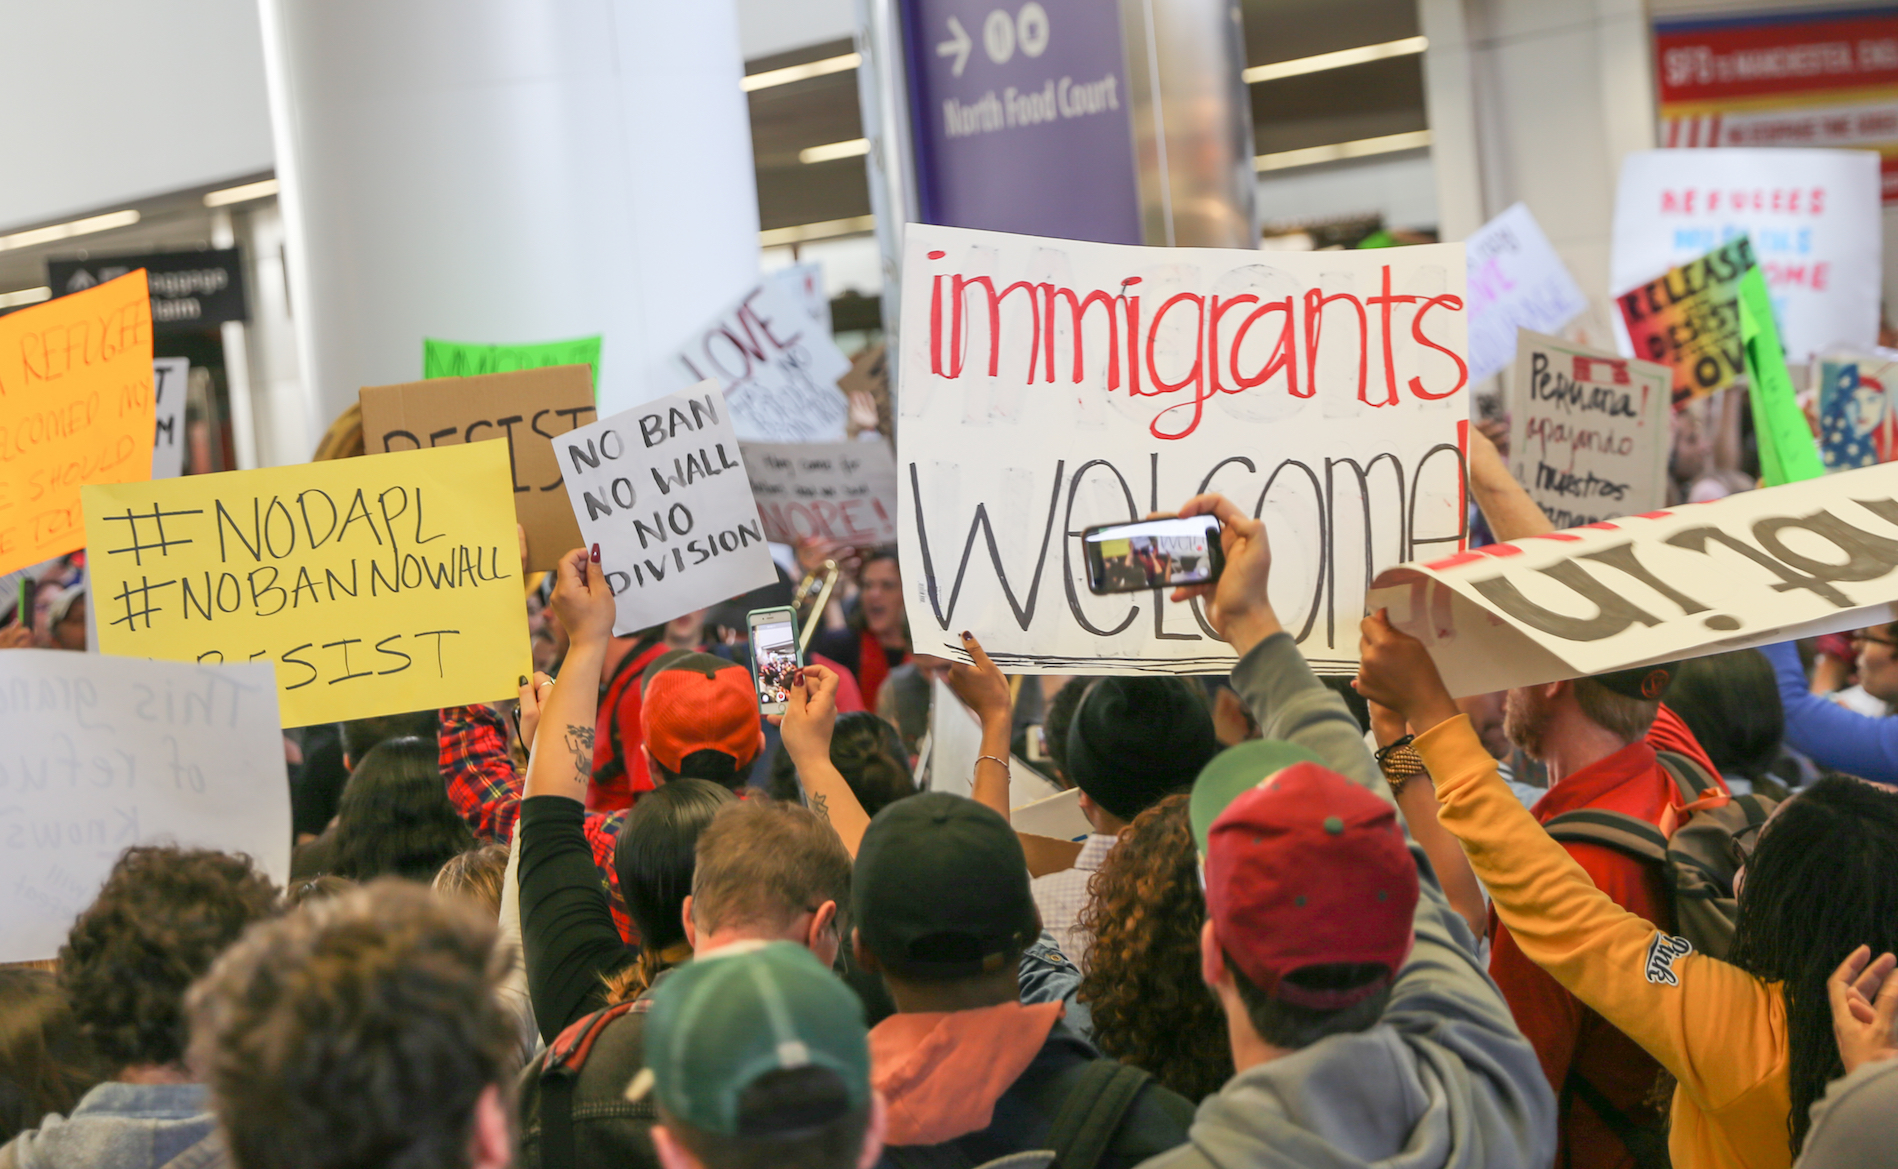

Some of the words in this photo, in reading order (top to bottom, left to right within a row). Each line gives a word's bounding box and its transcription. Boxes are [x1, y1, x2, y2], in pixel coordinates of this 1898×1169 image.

[943, 90, 1004, 138] North
[1003, 79, 1058, 128] Food
[1056, 73, 1119, 118] Court
[149, 267, 229, 297] aggage
[927, 250, 1469, 440] immigrants
[569, 429, 624, 474] NO
[639, 393, 720, 448] BAN
[584, 477, 638, 521] NO
[651, 443, 740, 496] WALL
[102, 485, 447, 567] #NODAPL
[604, 518, 763, 598] DIVISION
[633, 502, 694, 550] NO
[196, 629, 460, 691] SIST
[1645, 931, 1692, 986] Pink
